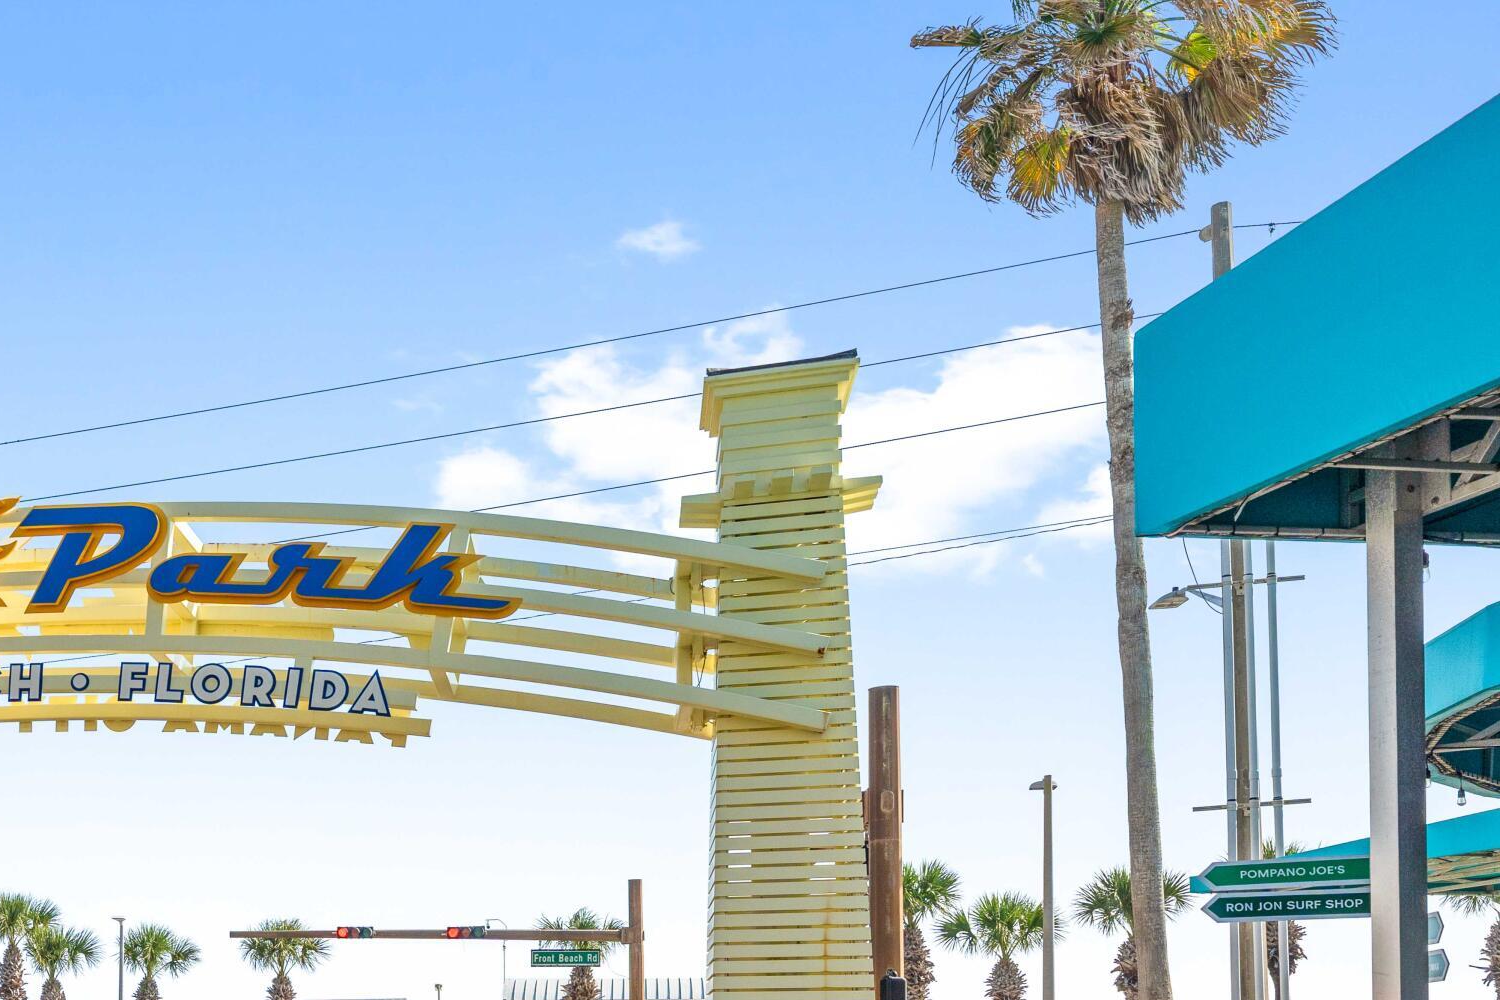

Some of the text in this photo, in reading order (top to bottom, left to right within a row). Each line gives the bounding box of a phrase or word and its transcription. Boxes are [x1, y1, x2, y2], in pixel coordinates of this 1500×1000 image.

[10, 502, 524, 620] Park
[117, 661, 392, 718] FLORIDA
[1239, 865, 1346, 879] POMPANO JOE'S
[1226, 898, 1364, 913] RON JON SURF SHOP
[534, 953, 598, 963] Front Beach Rd
